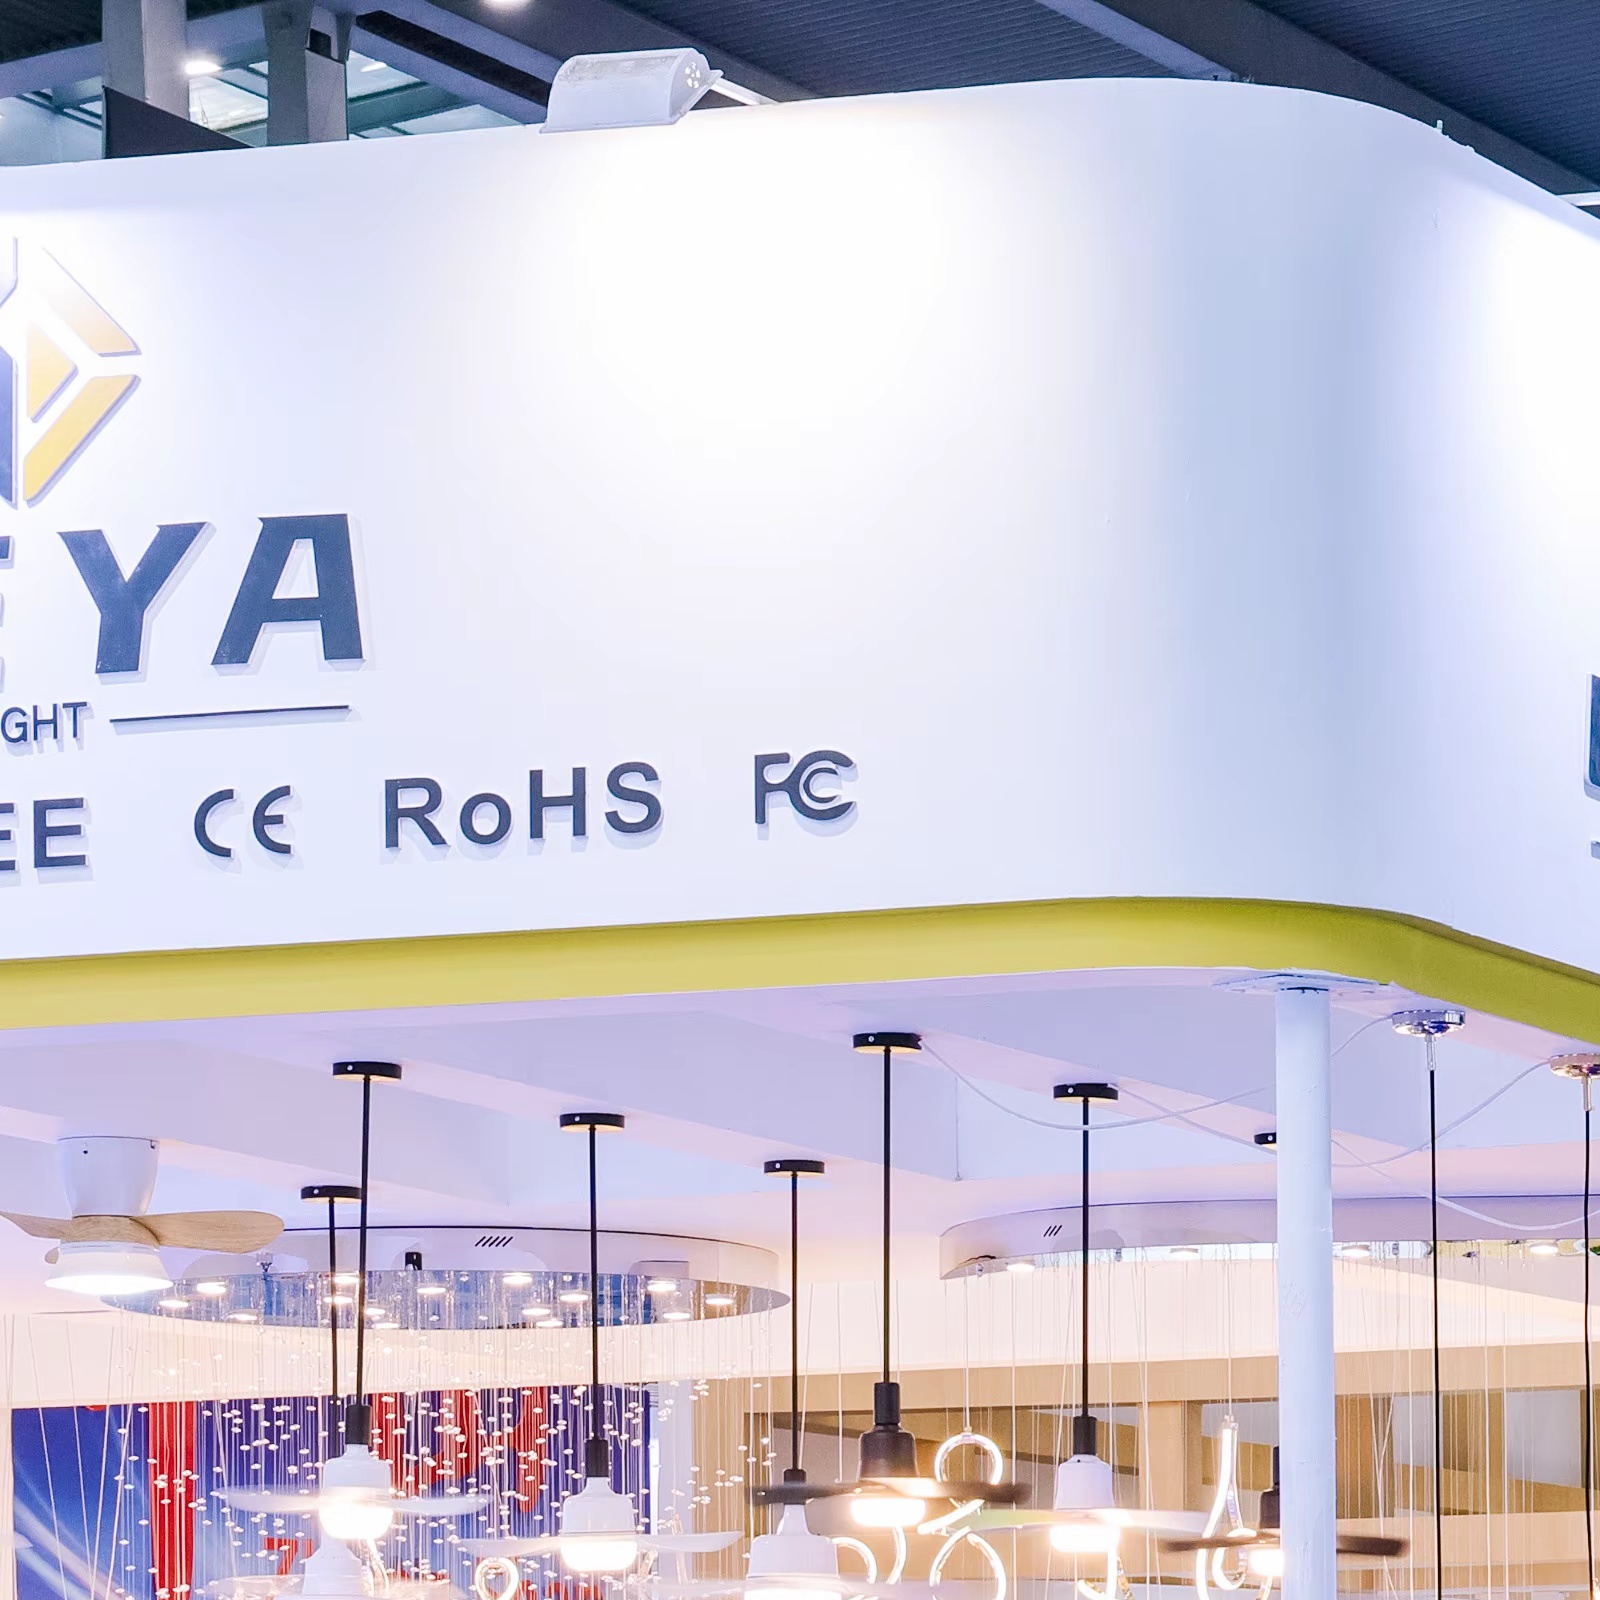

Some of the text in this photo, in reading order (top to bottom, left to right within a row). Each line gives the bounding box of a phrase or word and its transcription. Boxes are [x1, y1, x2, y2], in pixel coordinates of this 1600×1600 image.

[0, 514, 364, 675] YA
[194, 785, 291, 858] CE
[385, 762, 661, 850] RoHS
